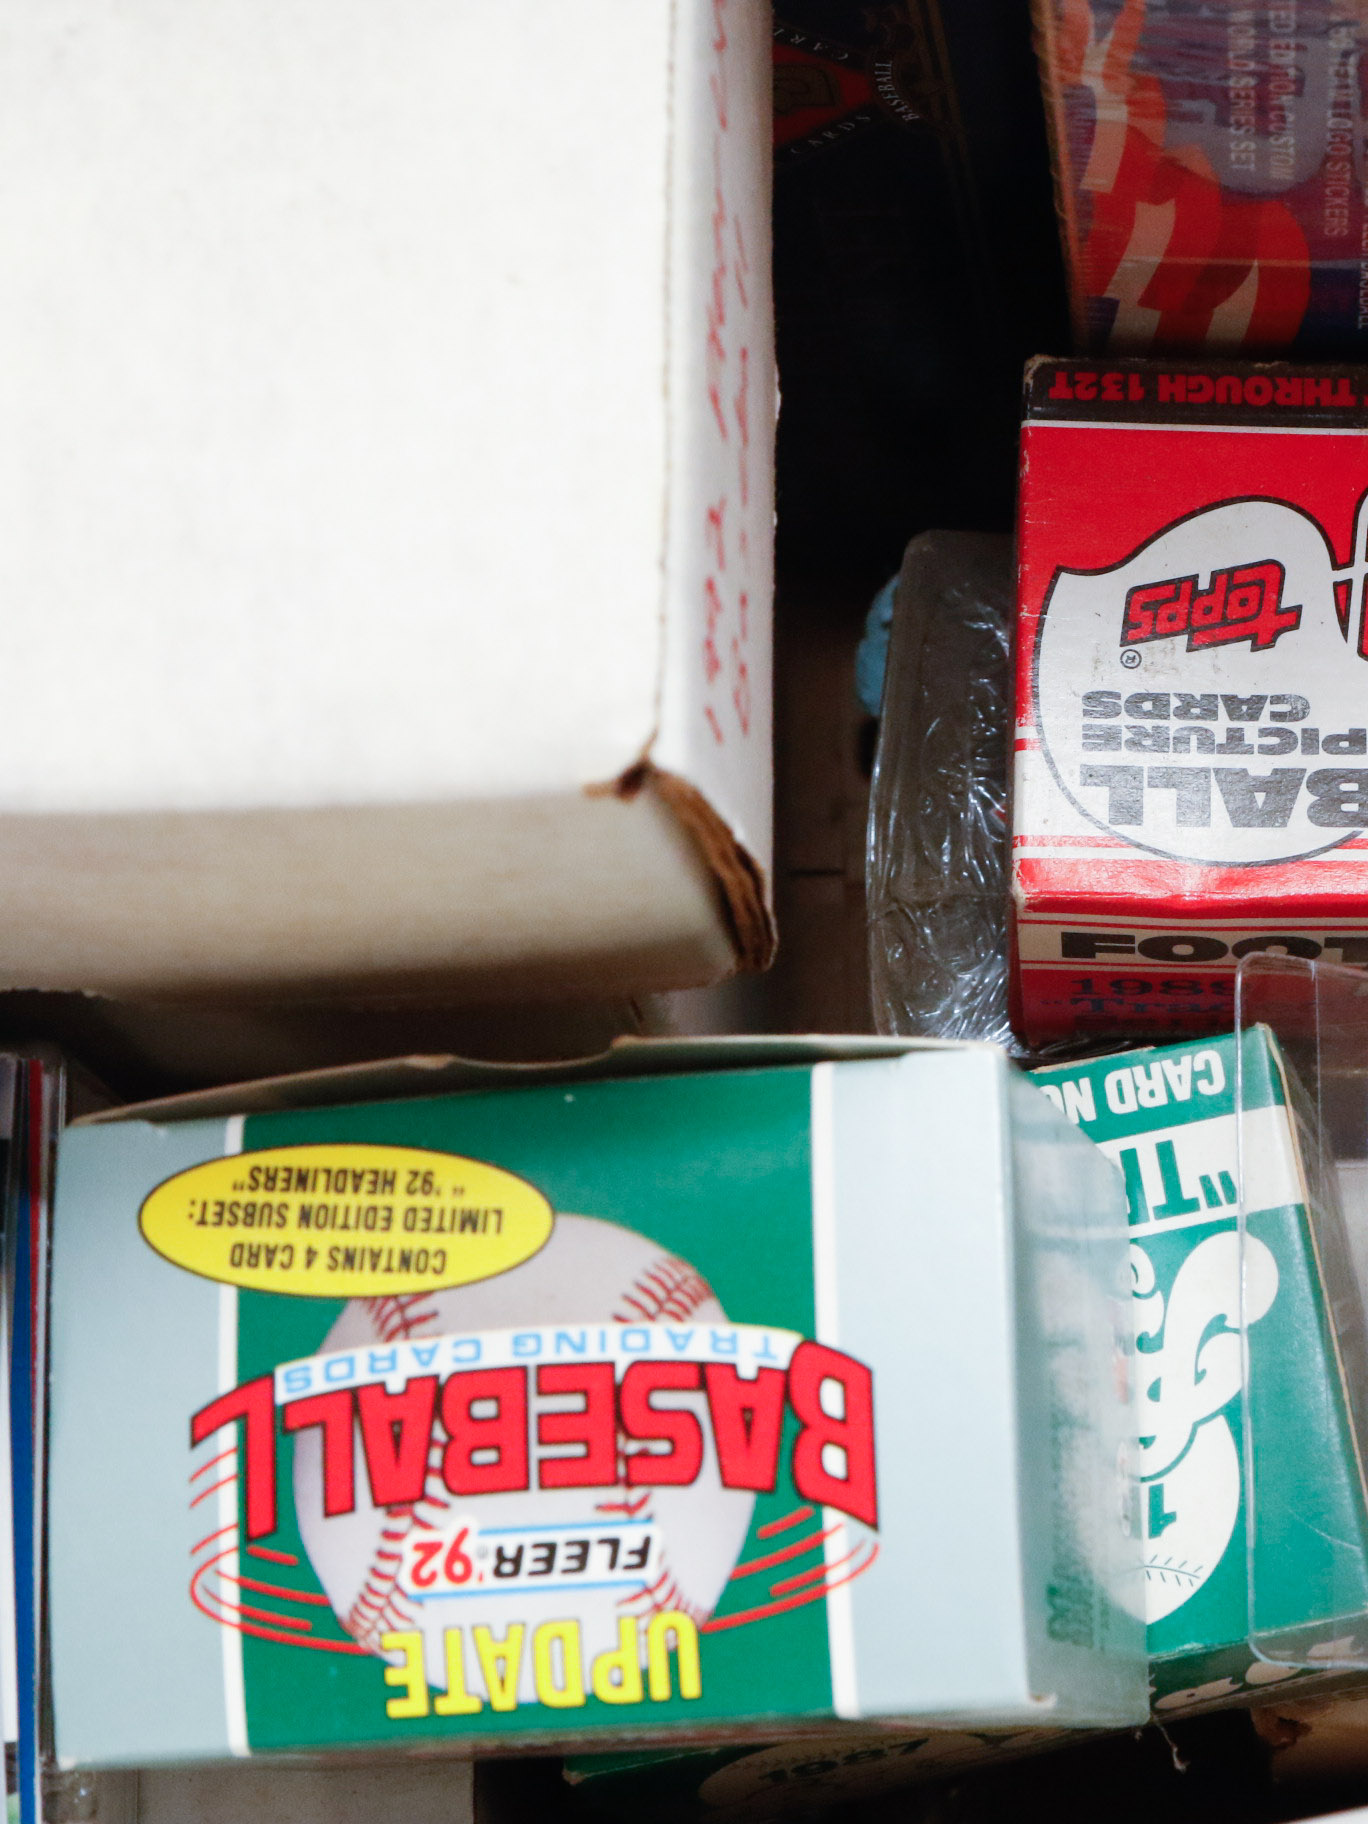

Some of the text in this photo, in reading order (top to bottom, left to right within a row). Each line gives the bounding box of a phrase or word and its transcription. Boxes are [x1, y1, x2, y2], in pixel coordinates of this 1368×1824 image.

[1229, 75, 1256, 136] SERIES
[1230, 140, 1256, 171] SET
[1324, 159, 1352, 237] STICKERS
[1048, 370, 1144, 402] 132T
[1158, 374, 1354, 406] THROUGH
[1081, 690, 1311, 723] CARDS
[1081, 723, 1367, 756] PICTURE
[1105, 1048, 1227, 1115] CARD
[187, 1200, 505, 1236] LIMITED EDITION SUBSET:
[228, 1242, 448, 1276] CONTAINS 4 CARD
[280, 1327, 779, 1395] TRADING CARDS
[189, 1339, 879, 1543] BASEBALL
[490, 1532, 652, 1581] FLEER
[379, 1609, 704, 1719] UPDATE
